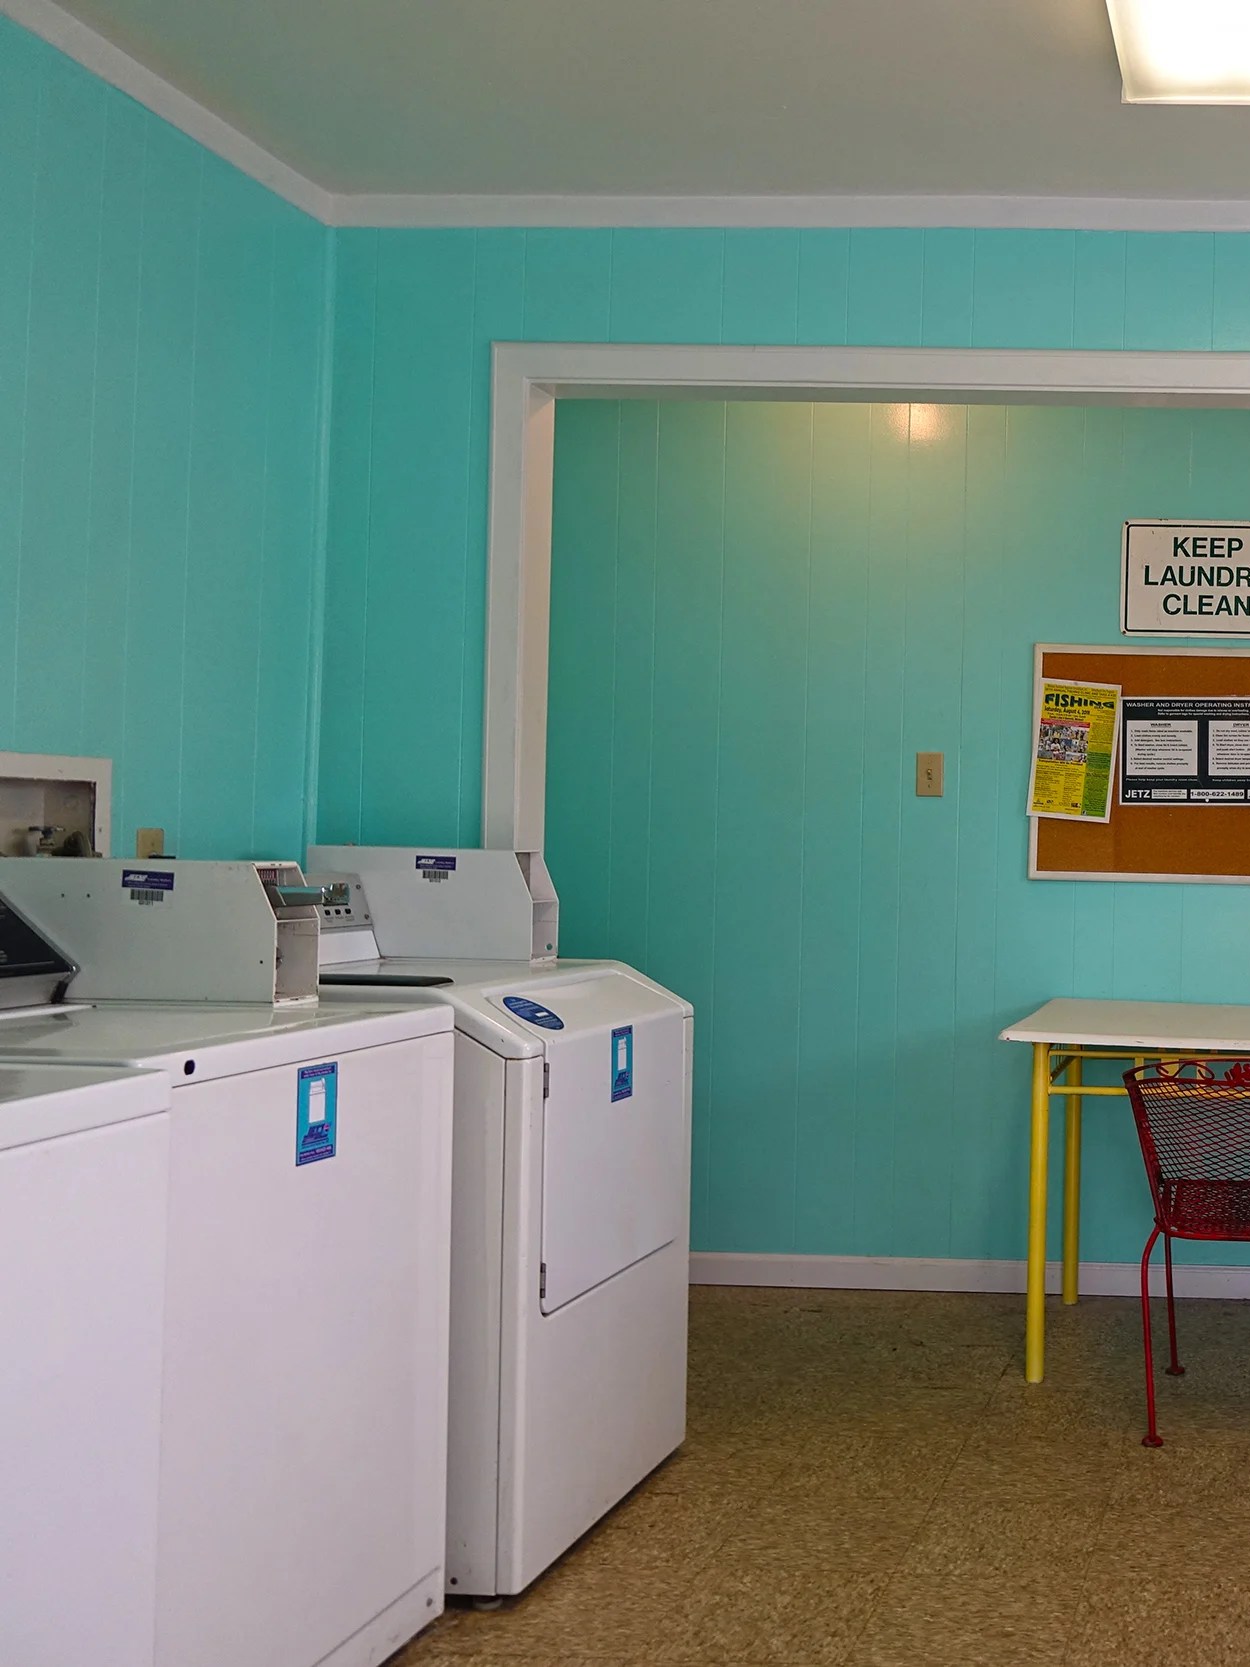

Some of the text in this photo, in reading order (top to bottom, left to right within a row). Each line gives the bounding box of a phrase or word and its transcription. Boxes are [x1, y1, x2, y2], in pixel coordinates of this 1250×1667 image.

[1173, 536, 1243, 558] KEEP
[1044, 693, 1115, 709] FISHING
[1125, 789, 1151, 799] JETZ
